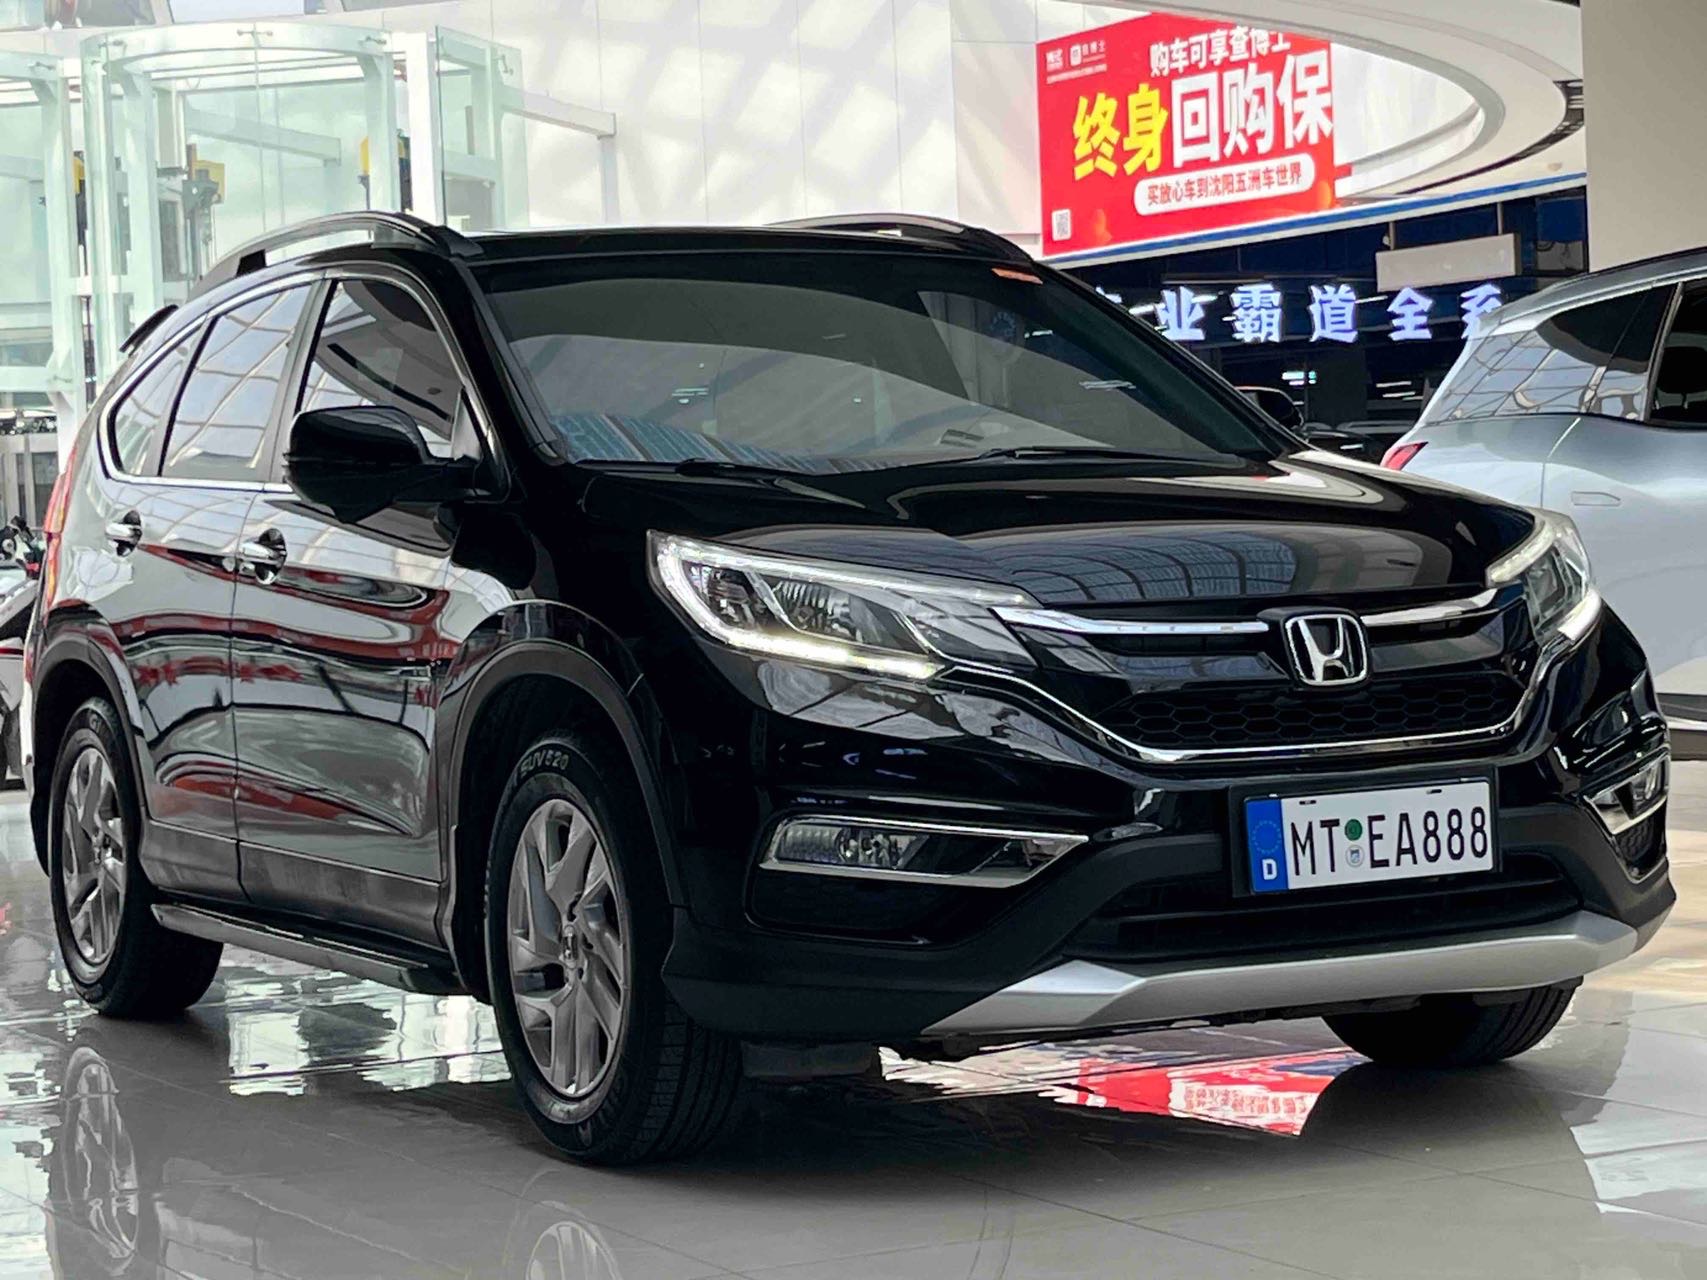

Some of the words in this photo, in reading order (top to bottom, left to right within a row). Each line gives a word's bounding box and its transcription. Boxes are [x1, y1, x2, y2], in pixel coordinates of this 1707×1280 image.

[1073, 62, 1333, 180] 终身回购保
[1147, 161, 1302, 206] 买放心车到沈阳五洲车世界
[1096, 283, 1502, 342] 业霸道全系
[1261, 858, 1278, 880] D
[1290, 818, 1340, 876] MT
[1367, 806, 1488, 868] EA888
